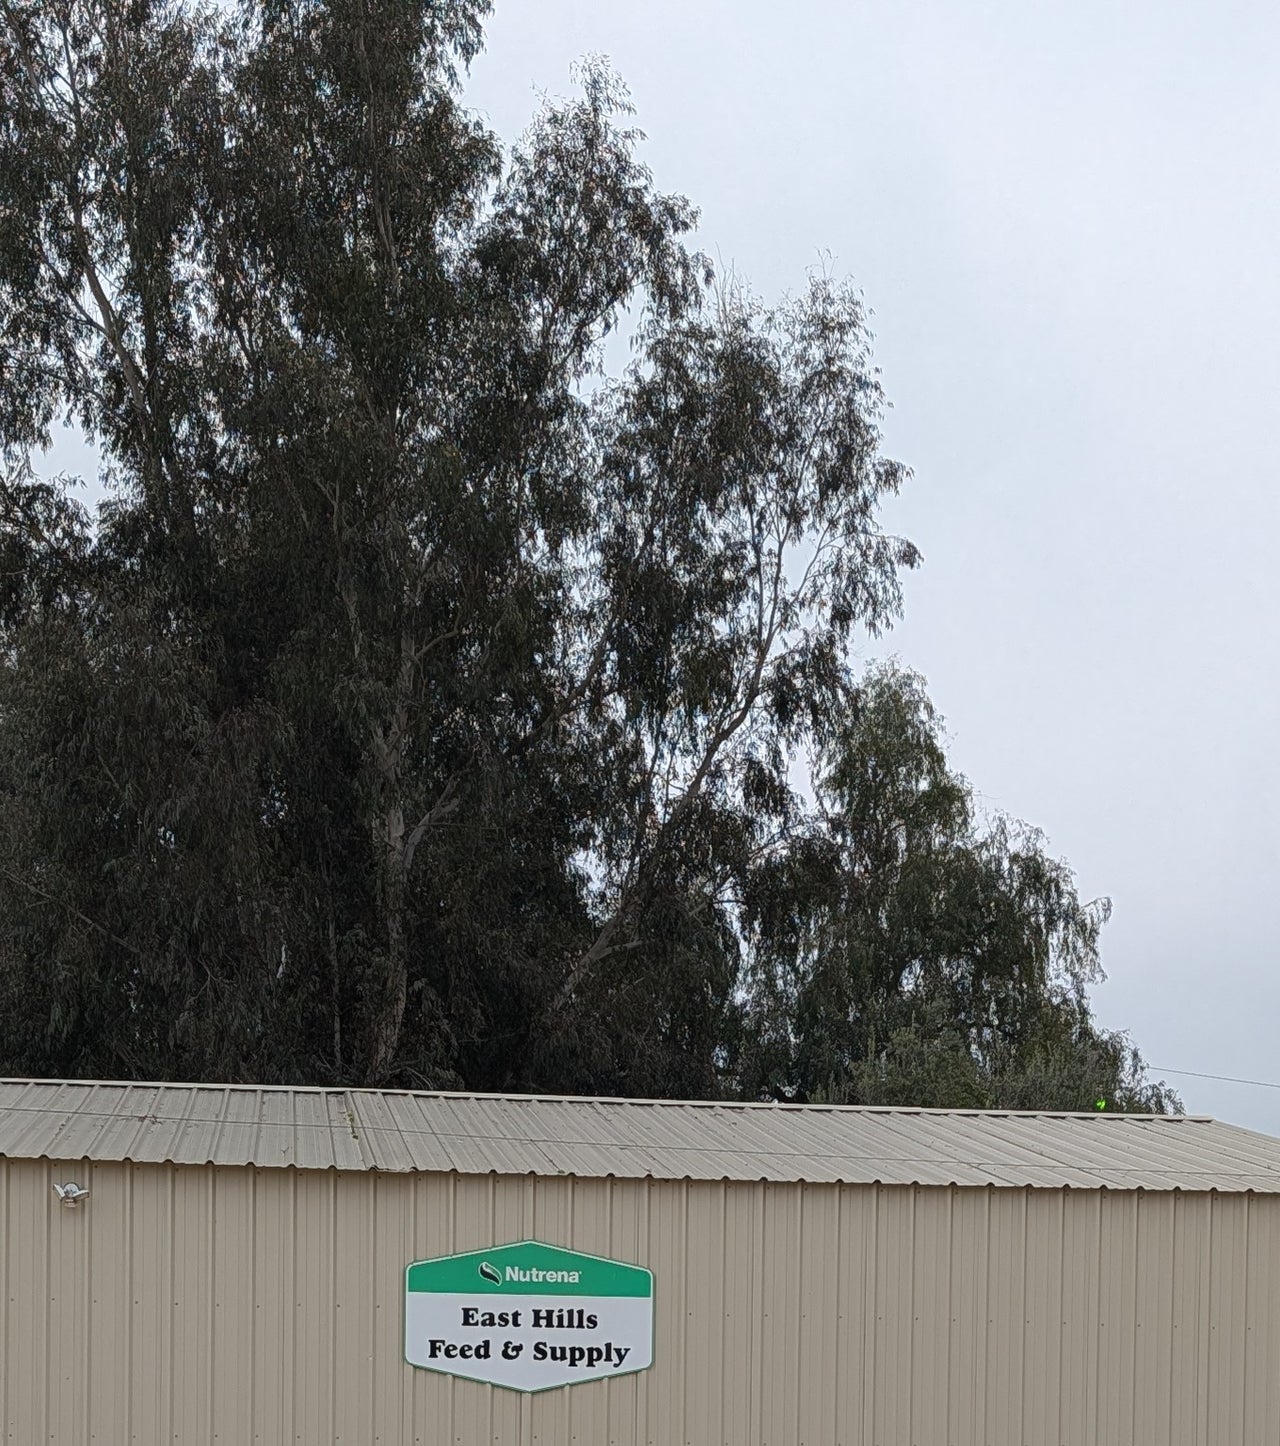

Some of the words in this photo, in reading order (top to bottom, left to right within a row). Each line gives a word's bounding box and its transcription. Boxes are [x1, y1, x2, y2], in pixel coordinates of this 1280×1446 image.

[505, 1266, 580, 1283] Nutrena
[461, 1307, 522, 1328] East
[531, 1308, 599, 1330] Hills
[428, 1339, 492, 1360] Feed
[501, 1340, 524, 1360] &
[533, 1341, 631, 1368] Supply
